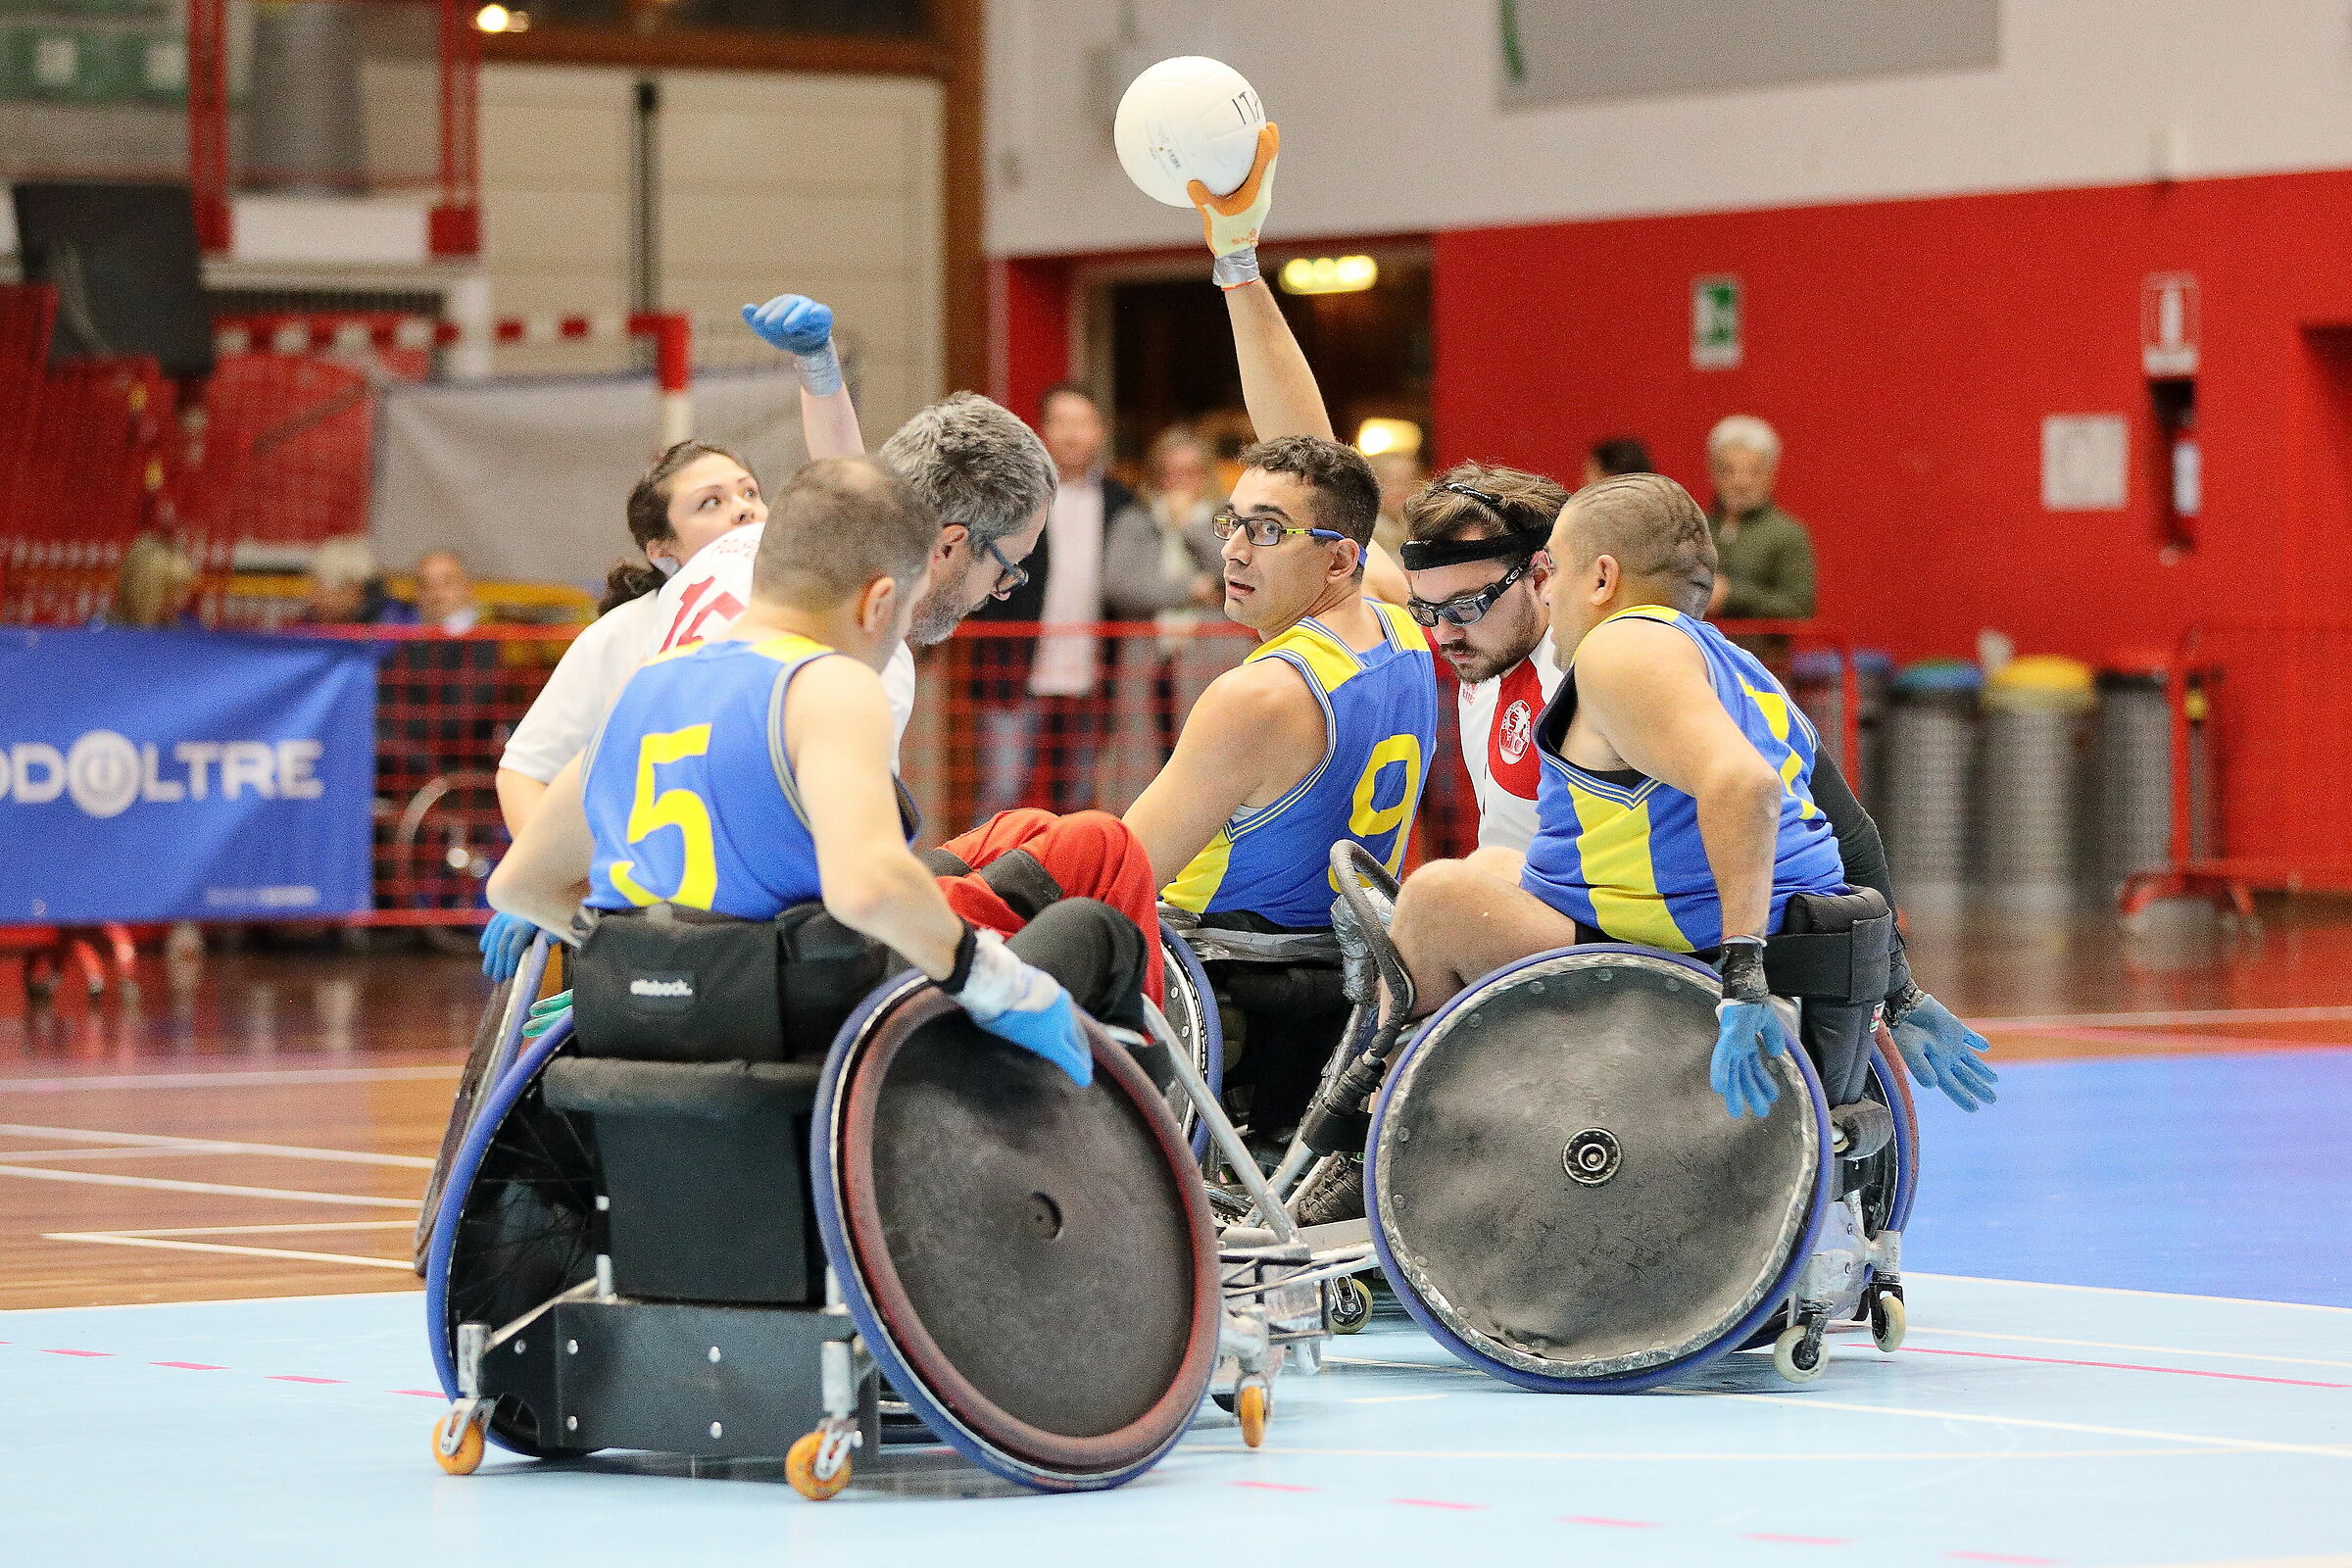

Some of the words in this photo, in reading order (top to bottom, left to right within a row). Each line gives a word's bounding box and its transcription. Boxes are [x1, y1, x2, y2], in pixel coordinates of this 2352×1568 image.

[0, 729, 324, 819] DOLTRE
[609, 723, 719, 911] 5
[1328, 734, 1421, 894] 9
